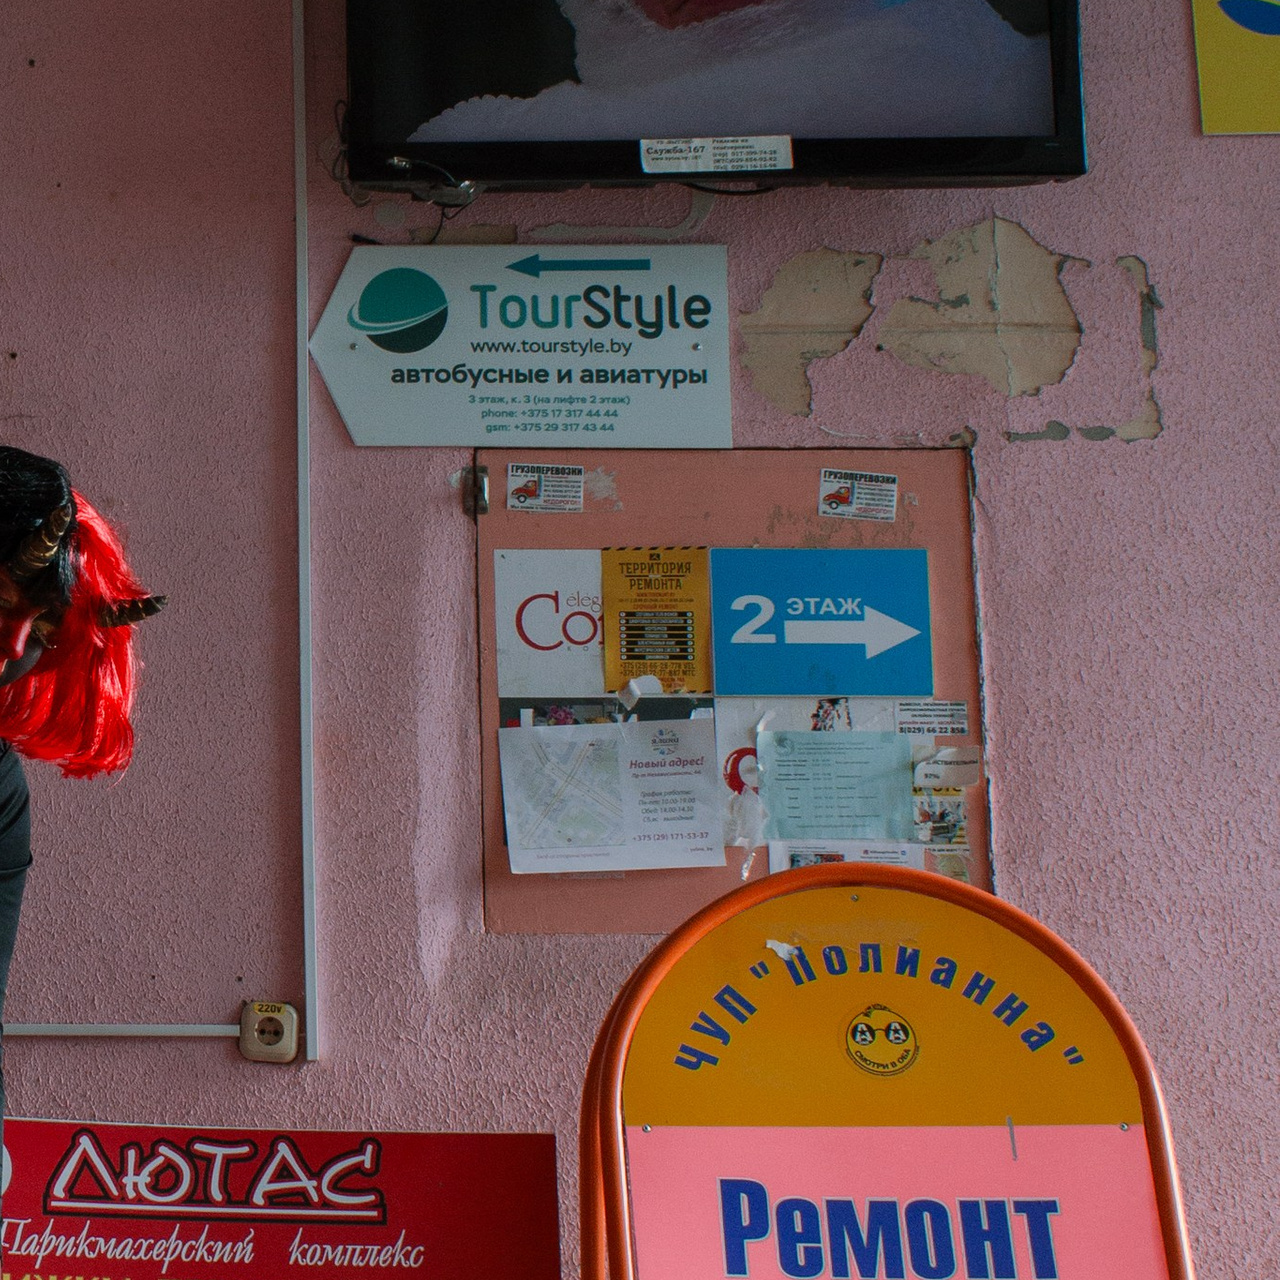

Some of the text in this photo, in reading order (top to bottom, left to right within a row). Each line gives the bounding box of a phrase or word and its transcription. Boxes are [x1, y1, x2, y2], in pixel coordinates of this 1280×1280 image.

[470, 284, 712, 339] TourStyle
[470, 338, 633, 357] www.tourstyle.by
[391, 363, 707, 389] автобусные и авиатуры
[468, 395, 476, 404] 3
[478, 396, 509, 405] этаж,
[553, 396, 587, 406] лифте
[589, 395, 597, 404] 2
[599, 395, 631, 406] этаж)
[481, 408, 619, 420] phone: +375 17 317 44 44
[485, 423, 511, 433] gsm:
[514, 423, 542, 432] +375
[544, 423, 559, 432] 29
[561, 423, 580, 432] 317
[599, 423, 615, 432] 44
[511, 464, 583, 476] ГРУЗОПЕРЕВОЗКИ
[823, 470, 897, 485] ГРУЗОПЕРЕВОЗКИ
[618, 562, 691, 574] ТЕРРИТОРИЯ
[629, 578, 682, 590] РЕМОНТА
[730, 594, 862, 644] 2 ЭТАЖ
[629, 756, 704, 769] Новый адрес!
[854, 1050, 890, 1070] СМОТРИ
[48, 1130, 382, 1207] ЛЮТАС
[716, 1176, 1060, 1280] Ремонт
[1, 1218, 425, 1274] Парикмахерский комплекс
